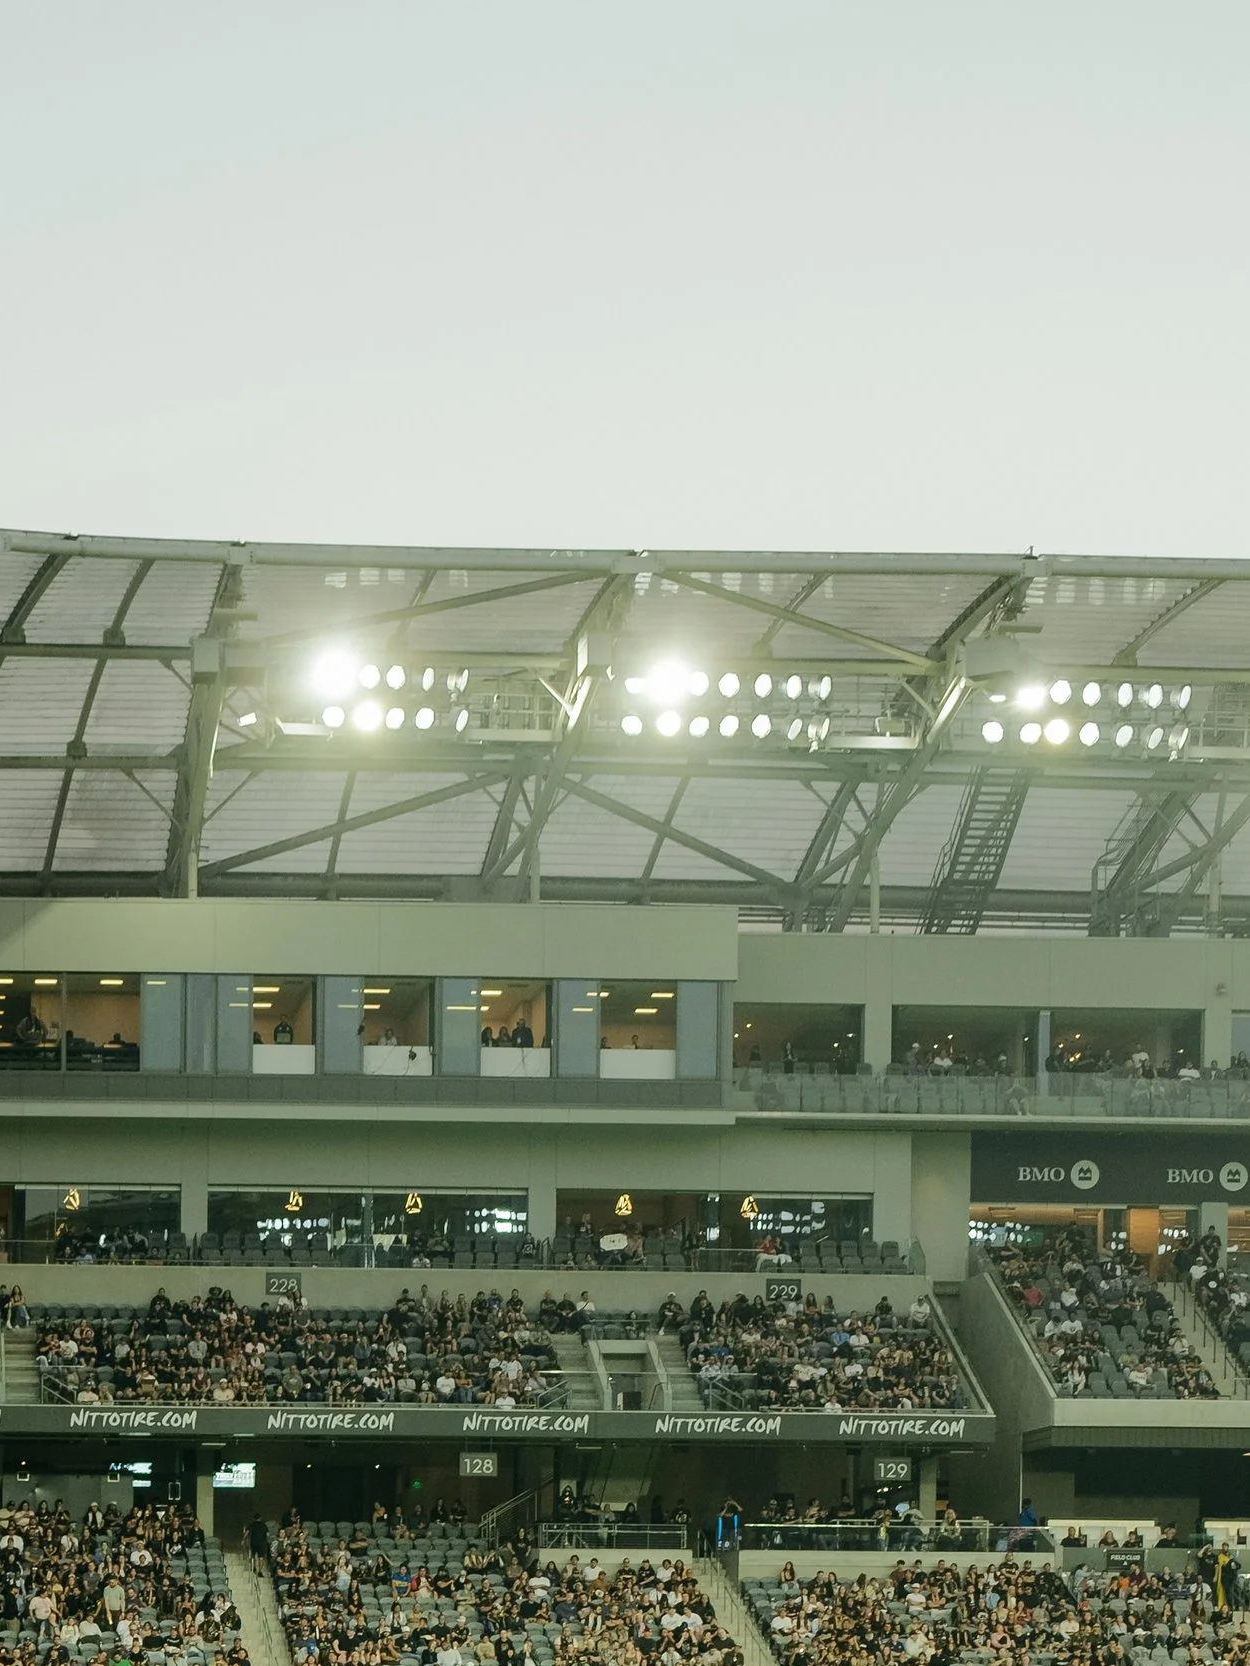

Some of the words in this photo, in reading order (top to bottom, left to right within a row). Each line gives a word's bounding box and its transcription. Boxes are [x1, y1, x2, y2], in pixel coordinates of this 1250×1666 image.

[1017, 1166, 1065, 1183] BMO
[1167, 1168, 1214, 1184] BMO
[269, 1278, 298, 1292] 228
[769, 1285, 798, 1300] 229
[70, 1408, 197, 1430] NITTOTIRE.COM
[267, 1410, 396, 1432] NITTOTIRE.COM
[463, 1412, 589, 1434] NITTOTIRE.COM
[655, 1414, 782, 1436] NITTOTIRE.COM
[839, 1416, 965, 1439] NITTOTIRE.COM
[463, 1458, 493, 1474] 128
[878, 1462, 908, 1479] 129
